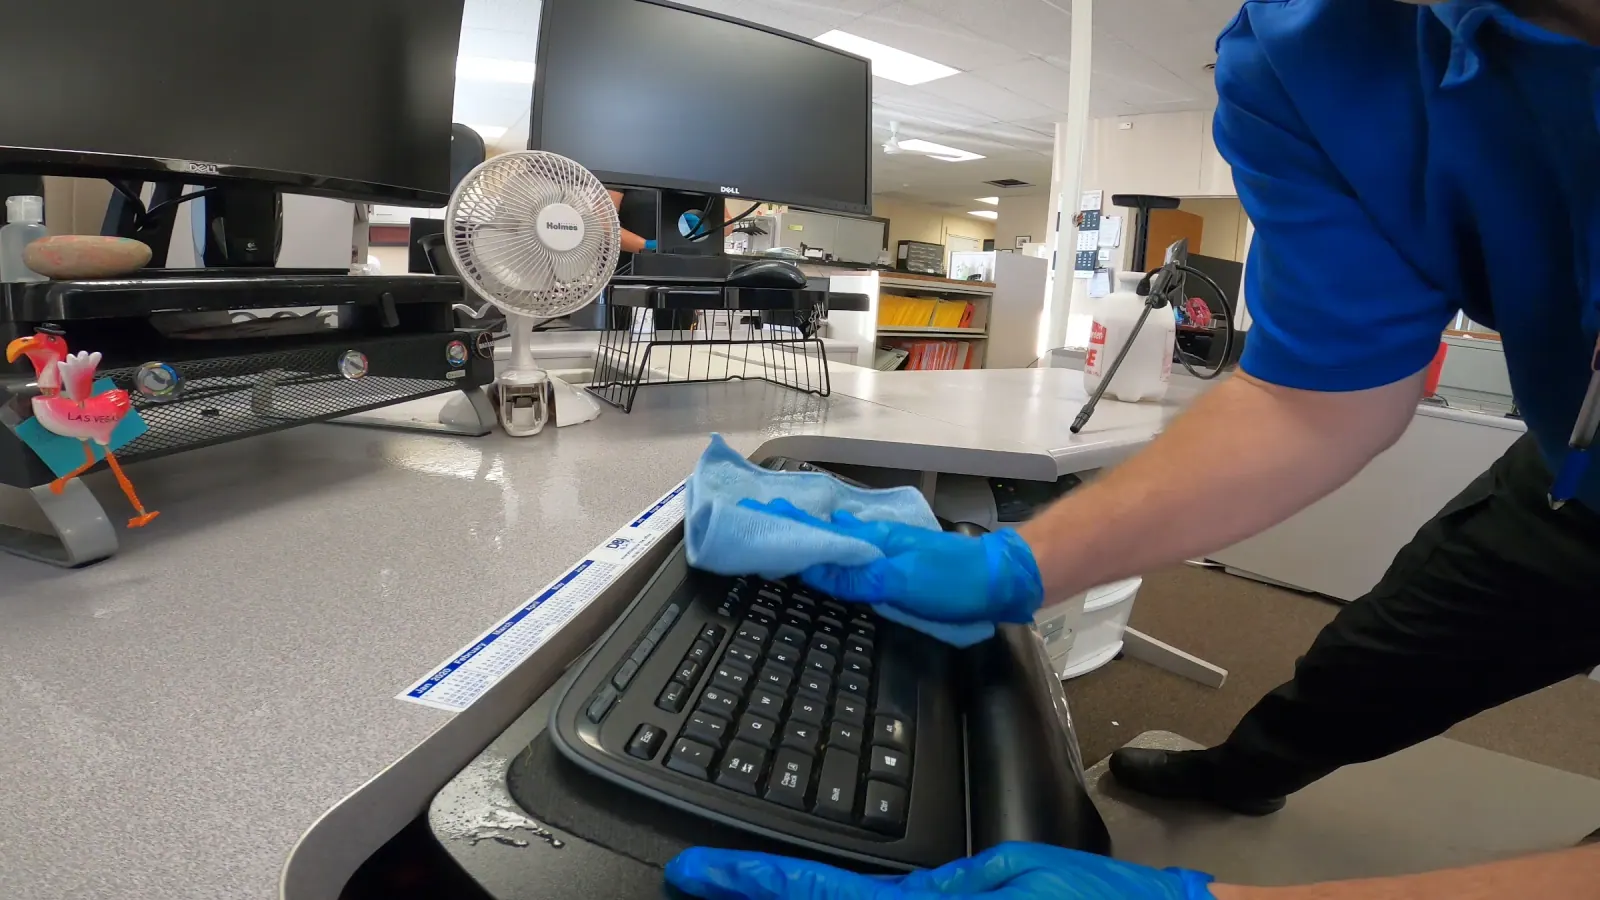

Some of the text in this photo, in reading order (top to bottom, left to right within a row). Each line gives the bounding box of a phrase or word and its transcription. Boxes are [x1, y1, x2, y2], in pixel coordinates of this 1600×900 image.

[189, 163, 219, 174] DELL
[720, 185, 740, 195] DELL
[546, 221, 578, 231] Holmes
[67, 411, 91, 423] LAS
[415, 682, 433, 694] Jan
[430, 668, 452, 682] 2020
[453, 642, 487, 665] February
[491, 621, 515, 636] March
[640, 731, 653, 743] Esc
[729, 758, 739, 769] Tab
[781, 772, 790, 786] Caps
[788, 775, 797, 788] Lock
[831, 788, 840, 801] Shift
[880, 800, 888, 812] Ctrl
